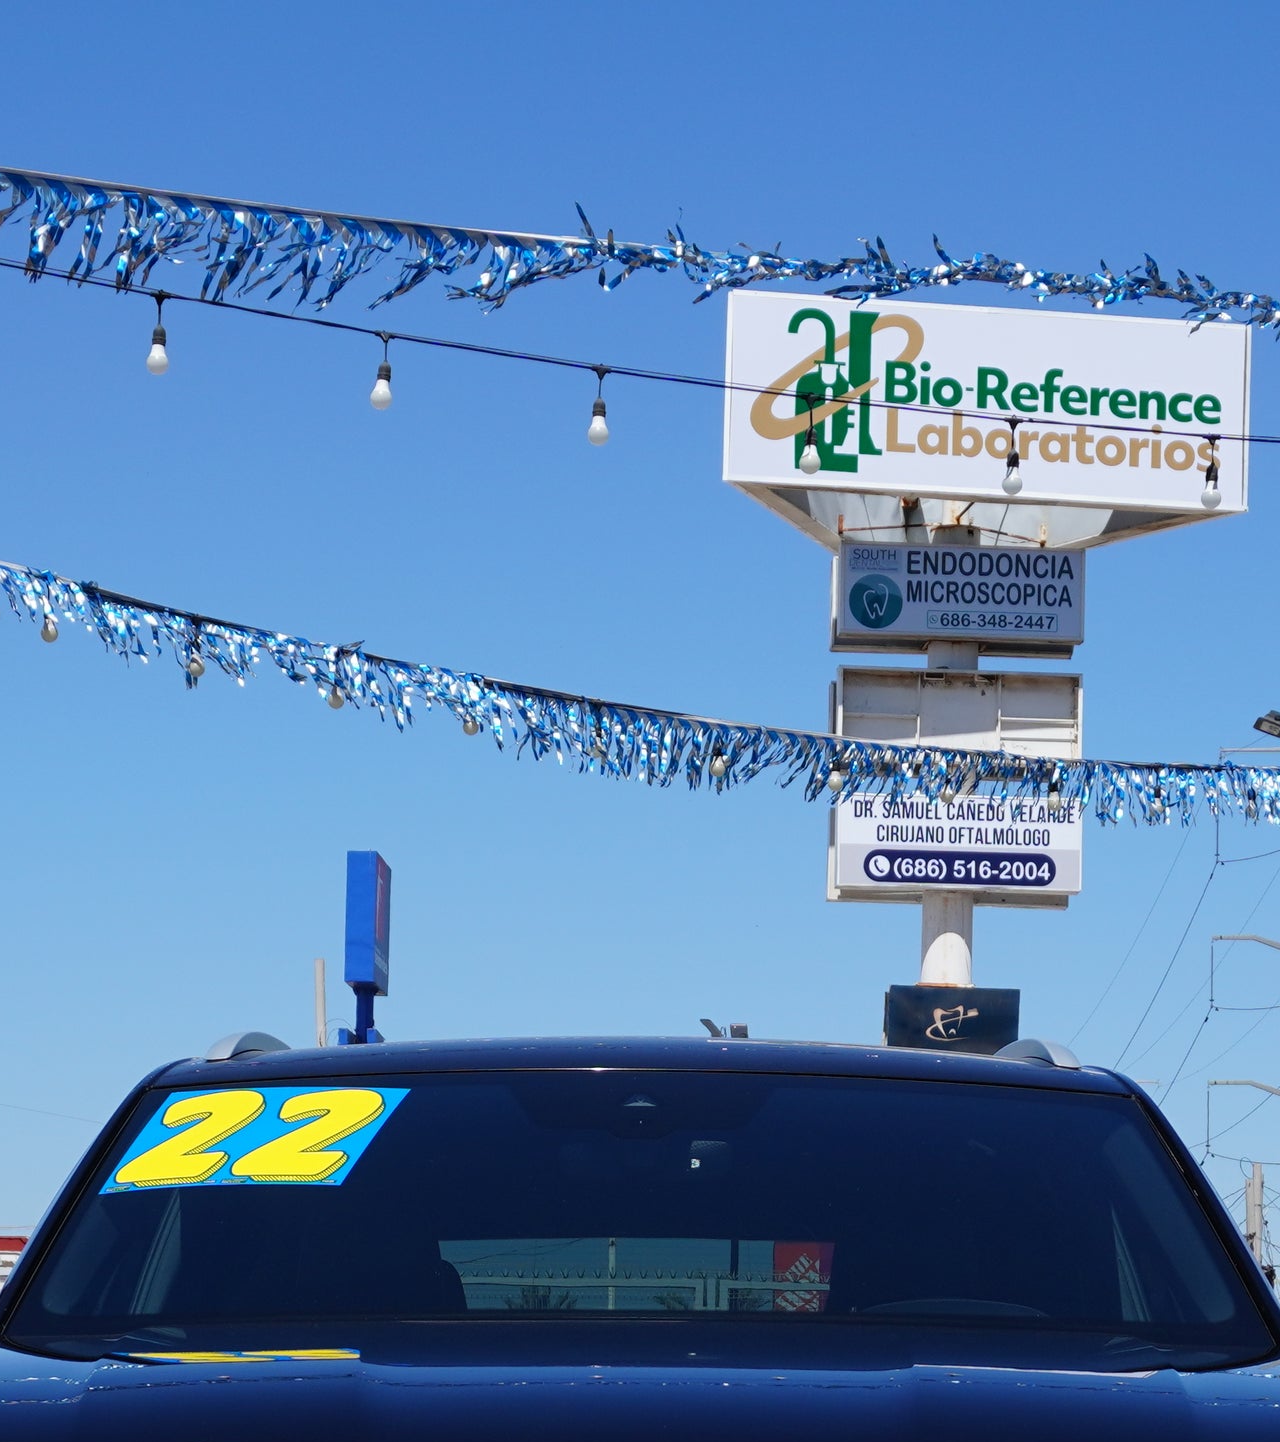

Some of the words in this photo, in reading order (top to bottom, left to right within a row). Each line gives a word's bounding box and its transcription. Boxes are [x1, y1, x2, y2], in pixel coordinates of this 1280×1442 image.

[886, 360, 1222, 425] Bio-Reference
[886, 408, 1222, 473] Laboratorios
[852, 548, 897, 561] SOUTH
[906, 550, 1075, 580] ENDODONCIA
[906, 580, 1073, 608] MICROSCOPICA
[939, 613, 1055, 630] 686-348-2447
[853, 801, 878, 818] DR.
[882, 802, 942, 820] SAMUEL
[946, 800, 1005, 822] CAÑEDO
[876, 824, 945, 844] CIRUJANO
[948, 825, 1051, 847] OFTALMÓLOGO
[893, 857, 948, 880] (686)
[953, 859, 1051, 881] 516-2004
[114, 1088, 386, 1188] 22
